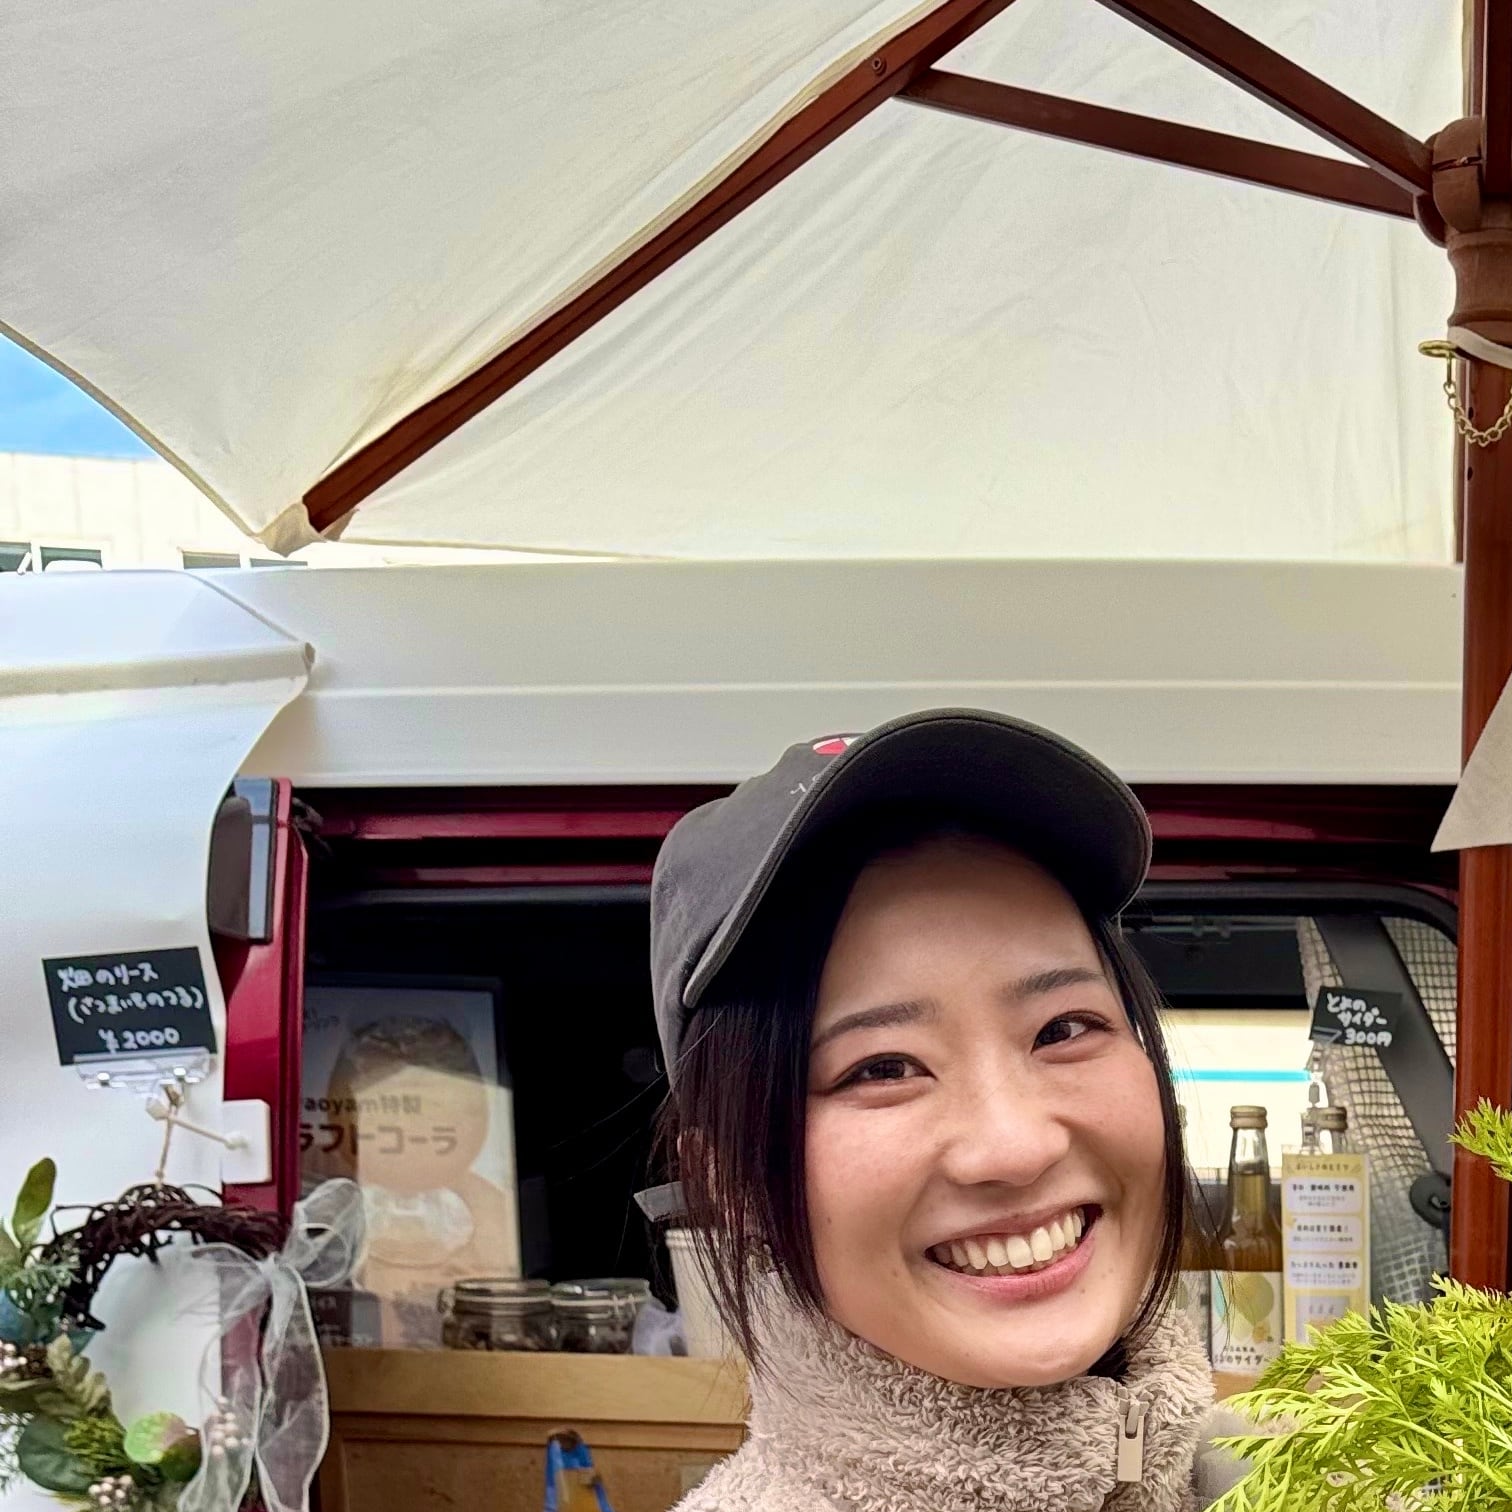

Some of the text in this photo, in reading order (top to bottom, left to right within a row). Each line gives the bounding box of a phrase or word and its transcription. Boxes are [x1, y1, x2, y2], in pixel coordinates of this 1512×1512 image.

[1344, 1027, 1393, 1047] 300円
[299, 1124, 458, 1156] ラフトコーラ
